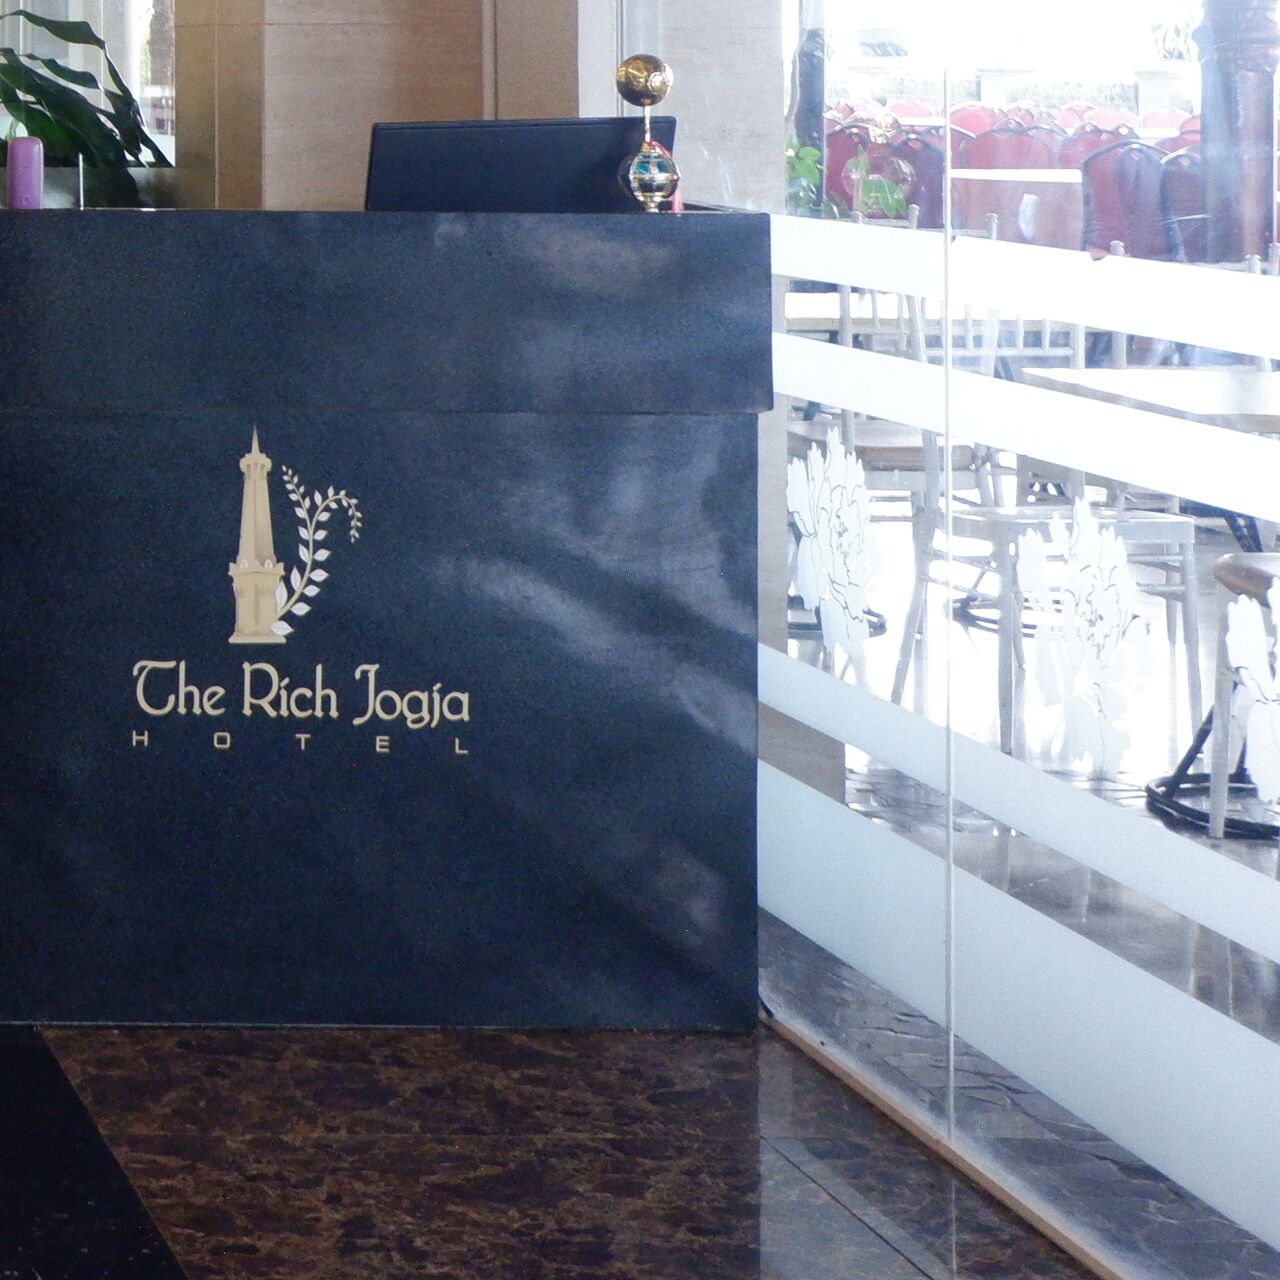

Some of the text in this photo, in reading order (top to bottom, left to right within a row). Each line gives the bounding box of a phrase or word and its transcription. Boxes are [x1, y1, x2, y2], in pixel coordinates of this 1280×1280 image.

[132, 659, 471, 730] The Rich Jogja
[131, 729, 470, 755] HOTEL
